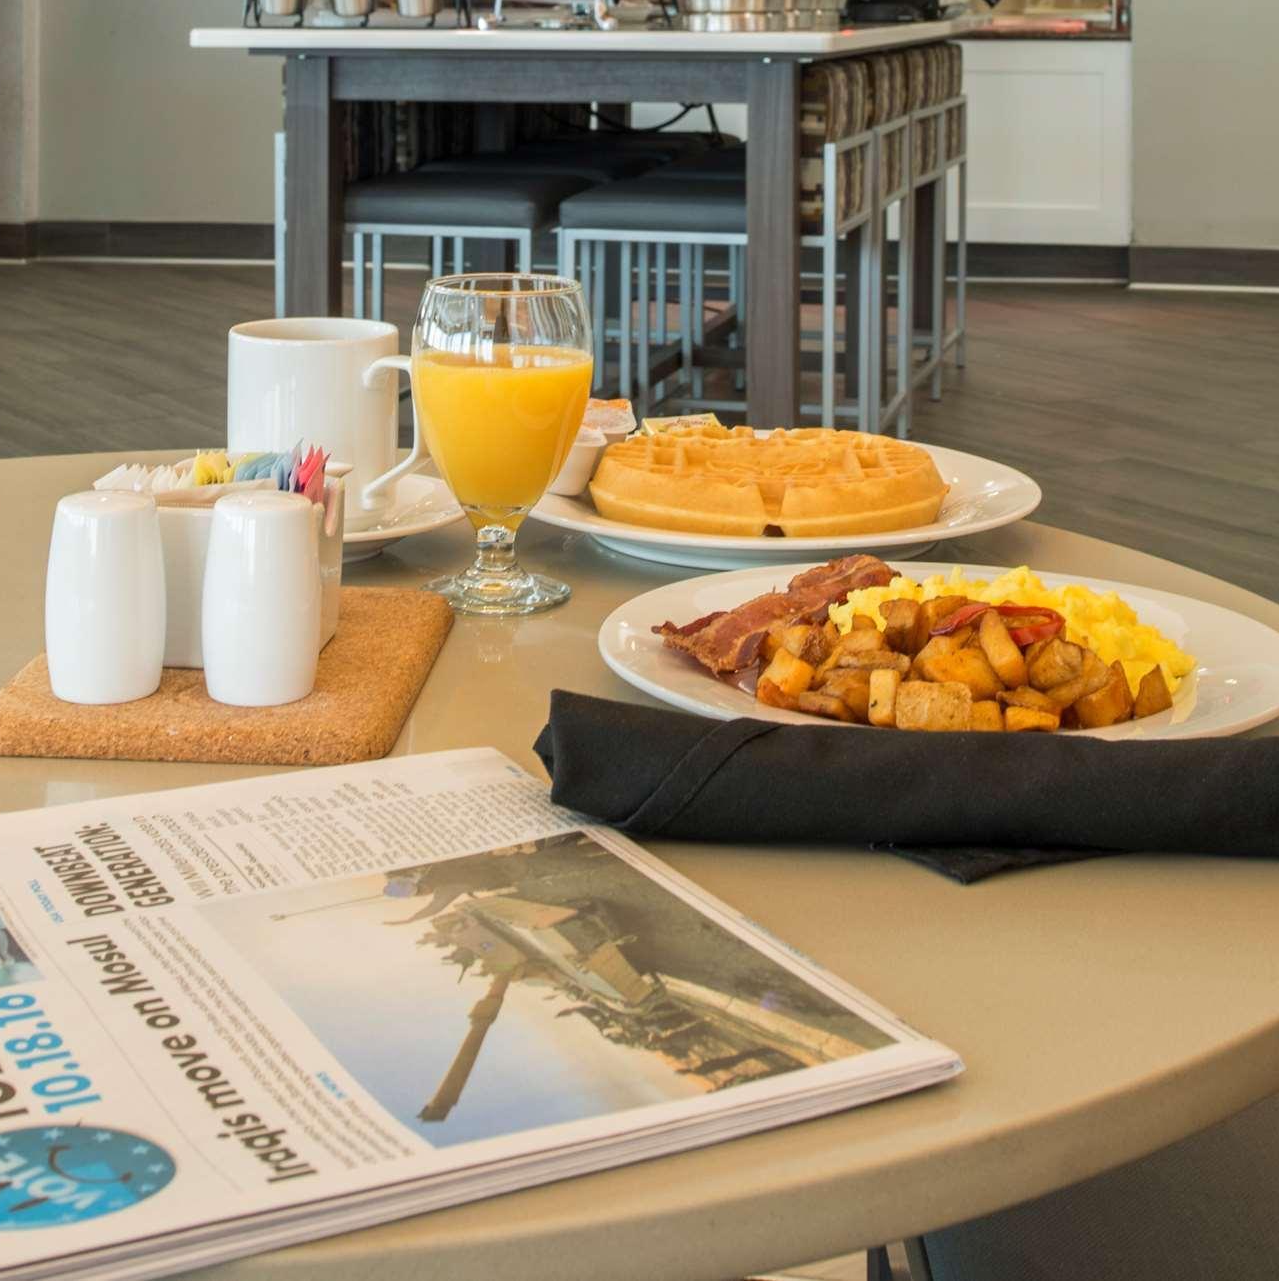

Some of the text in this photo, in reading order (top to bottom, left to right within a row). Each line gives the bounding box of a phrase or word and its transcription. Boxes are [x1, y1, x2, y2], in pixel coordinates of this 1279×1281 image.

[73, 822, 177, 909] GENERATION:
[139, 823, 160, 838] vote
[151, 814, 241, 895] the presidential race?
[33, 842, 126, 917] DOWNBEAT
[186, 880, 215, 899] Will
[66, 933, 156, 997] Mosul
[133, 996, 182, 1030] on
[161, 1032, 245, 1111] move
[217, 1112, 319, 1184] Iraqis
